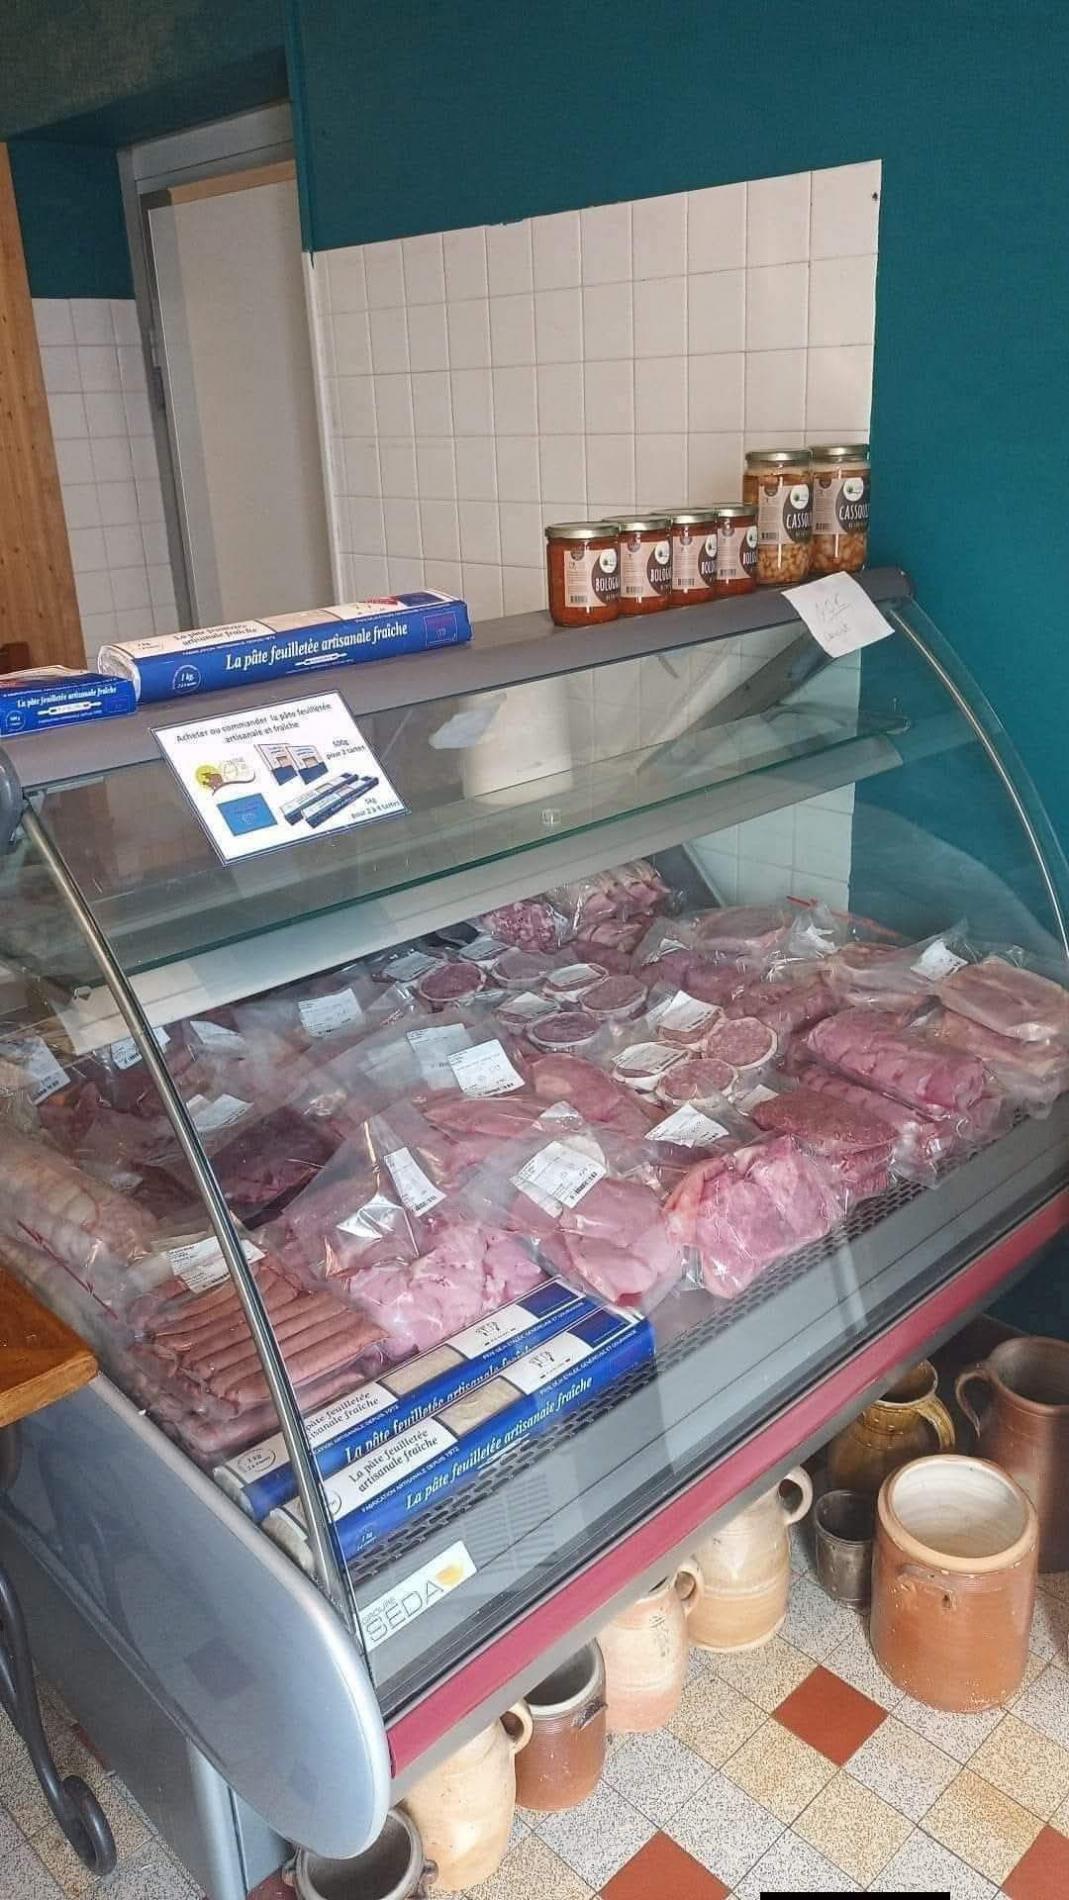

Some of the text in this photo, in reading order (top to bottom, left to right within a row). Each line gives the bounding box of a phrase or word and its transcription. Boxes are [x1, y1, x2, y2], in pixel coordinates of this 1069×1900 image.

[225, 654, 242, 670] La
[243, 649, 268, 671] pâte
[268, 638, 319, 665] feuilletée
[321, 628, 372, 650] artisanale
[372, 621, 408, 645] fraîche
[176, 730, 208, 742] Acheter
[221, 717, 267, 733] commander
[225, 729, 262, 743] artisanale
[325, 1392, 371, 1420] feuilletée
[344, 1398, 379, 1420] fraîche
[348, 1429, 429, 1483] La pâte feuilletée
[358, 1437, 438, 1492] artisanale fraîche
[406, 1377, 592, 1510] La pâte feuilletée artisanale fraîche
[366, 1580, 444, 1642] SEDA
